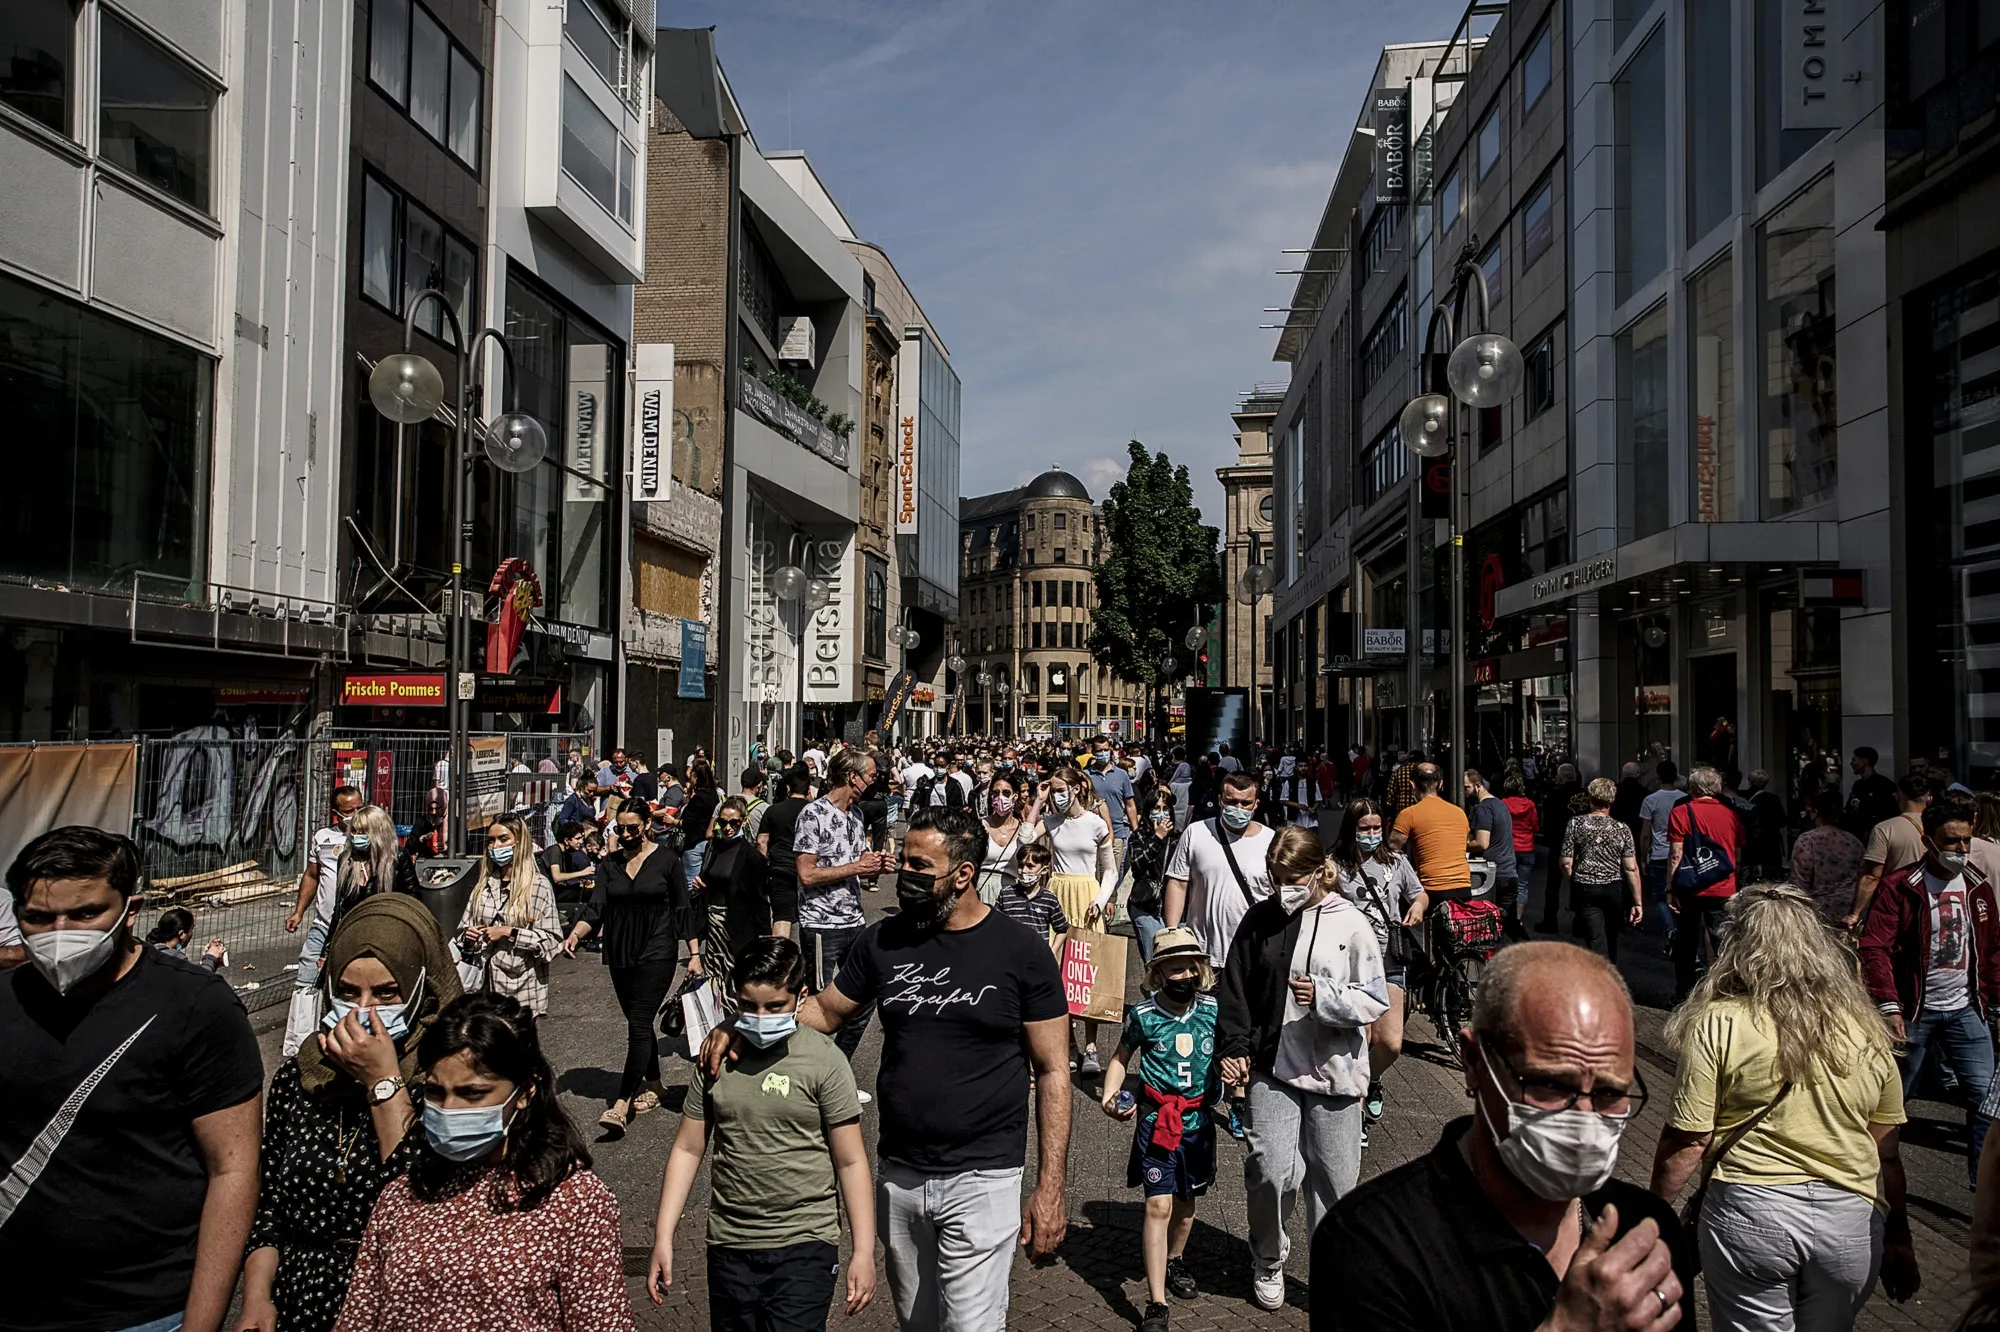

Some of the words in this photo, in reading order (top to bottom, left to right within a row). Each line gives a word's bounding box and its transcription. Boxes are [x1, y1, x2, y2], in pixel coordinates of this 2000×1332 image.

[1386, 123, 1404, 188] BABOR
[899, 416, 915, 523] SportScheck
[1573, 558, 1614, 587] HILFIGER
[1366, 636, 1403, 646] BABOR
[345, 680, 386, 697] Frische
[390, 681, 441, 697] Pommes
[1069, 938, 1092, 961] THE
[1067, 960, 1099, 985] ONLY
[1067, 982, 1091, 1005] BAG
[1177, 1062, 1192, 1087] 5
